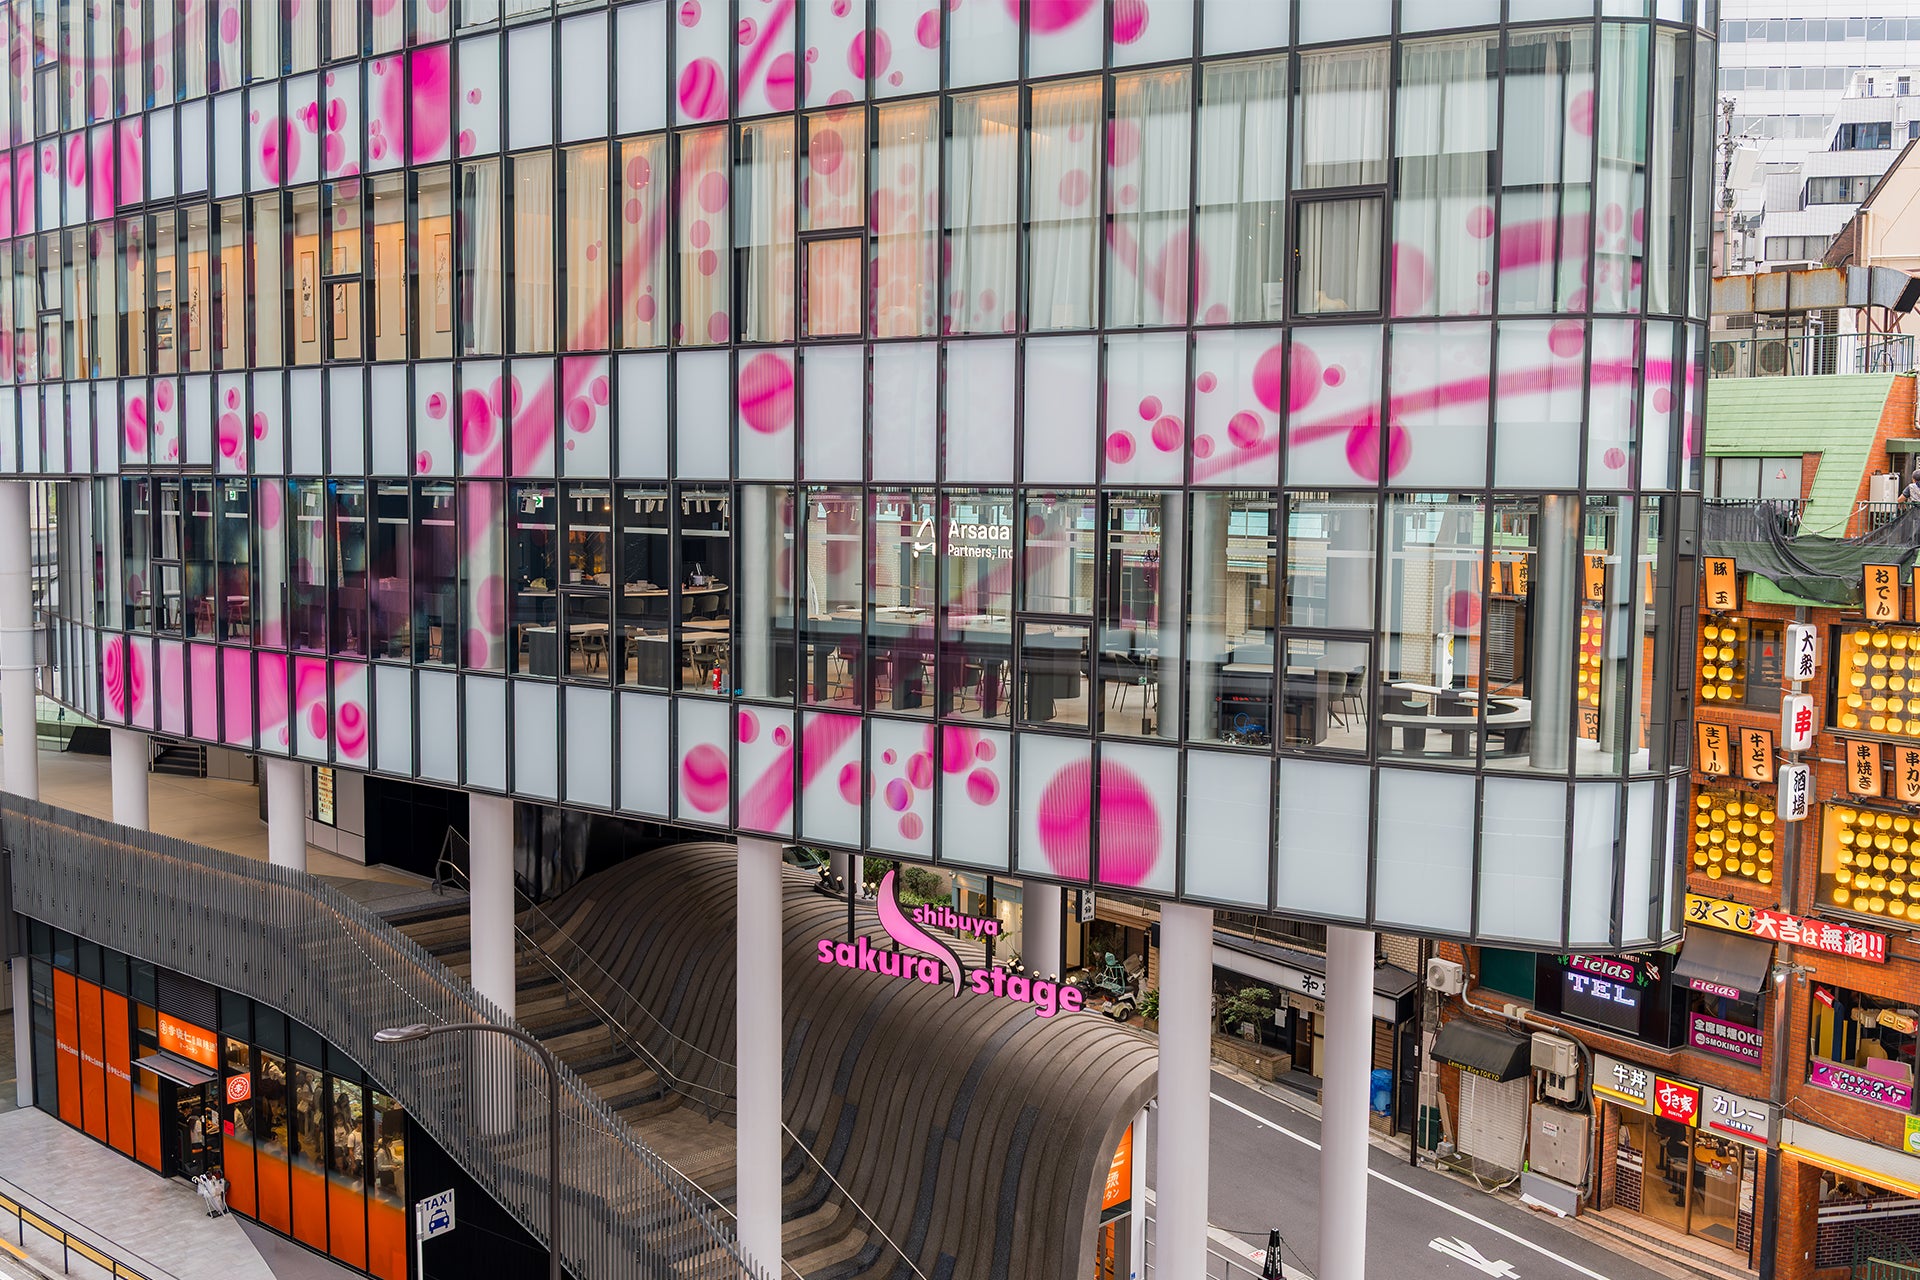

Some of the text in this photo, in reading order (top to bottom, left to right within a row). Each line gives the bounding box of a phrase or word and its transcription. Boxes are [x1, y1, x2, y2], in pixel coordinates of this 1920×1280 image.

[948, 543, 995, 561] Partners,
[1712, 561, 1729, 605] 豚玉
[1874, 569, 1891, 616] おでん
[1799, 630, 1814, 676] 大衆
[1795, 705, 1813, 742] 串
[1705, 727, 1722, 773] 生ビール
[1750, 733, 1765, 777] 牛どて
[1857, 744, 1872, 790] 串焼き
[1905, 751, 1920, 797] 串カツ
[1792, 770, 1807, 816] 酒場
[912, 903, 1000, 937] shibuya
[816, 936, 1085, 1019] sakura stage
[1572, 954, 1633, 980] Fields
[1567, 971, 1635, 1007] TEL
[1705, 1036, 1741, 1053] SMOKING
[1480, 1070, 1500, 1082] TOKYO
[1612, 1063, 1648, 1090] 牛丼
[1659, 1083, 1693, 1114] すき家
[1712, 1095, 1766, 1122] カレー
[1724, 1118, 1754, 1133] CURRY
[424, 1192, 453, 1211] TAXI
